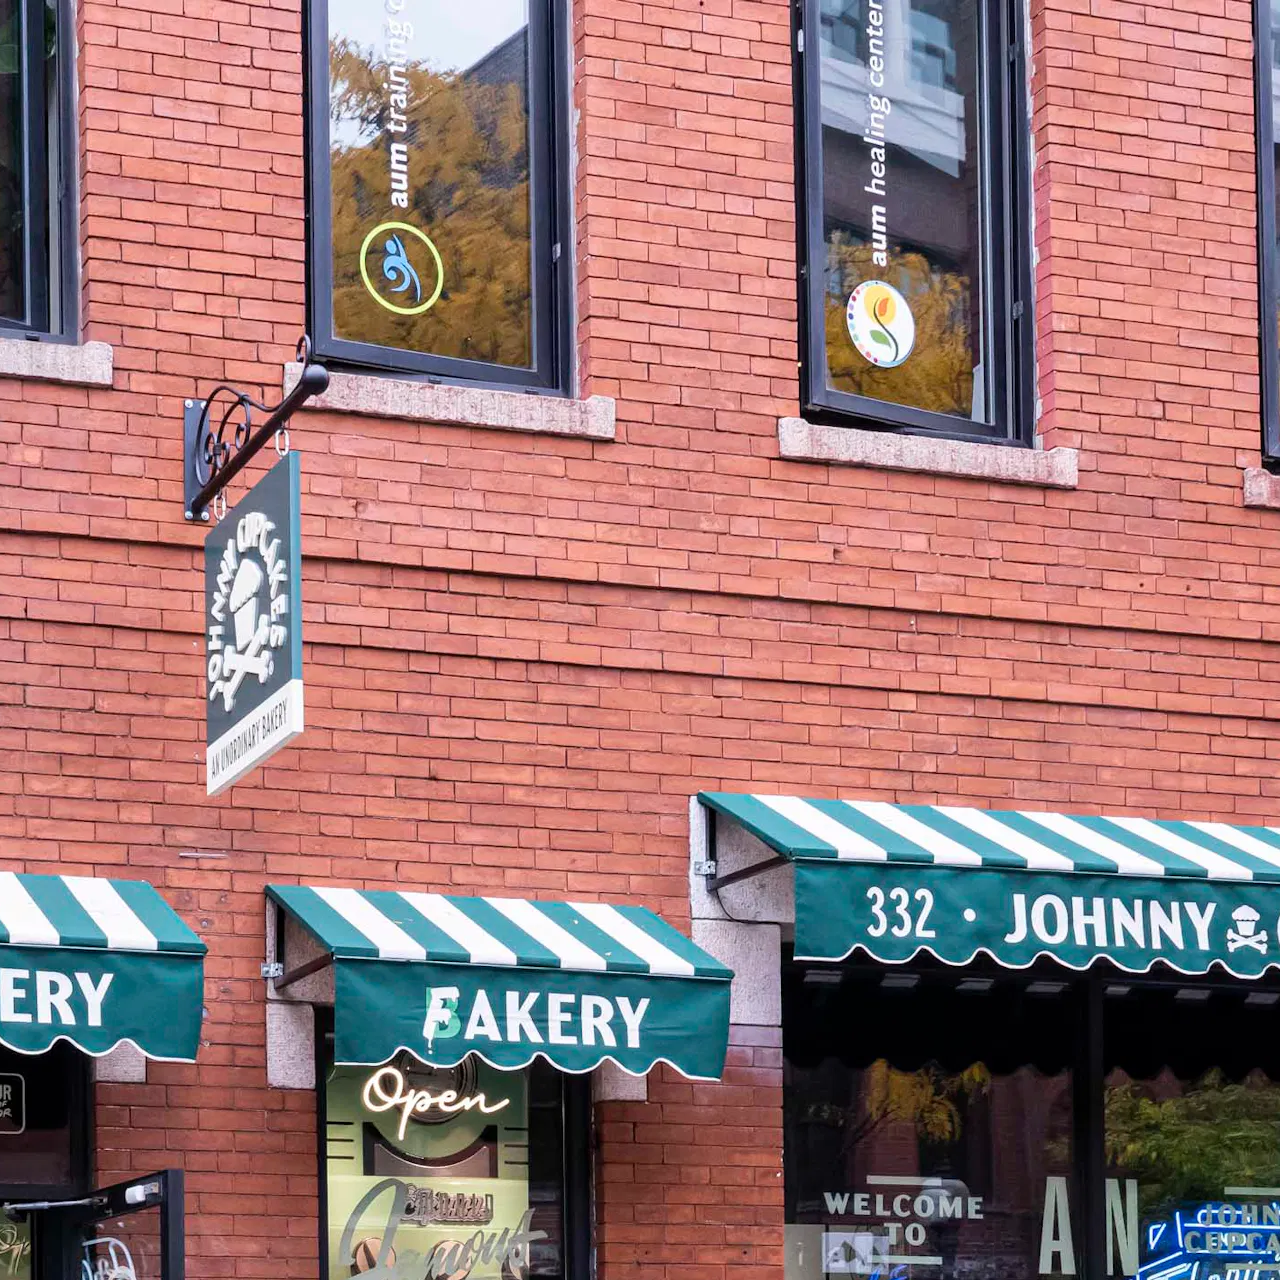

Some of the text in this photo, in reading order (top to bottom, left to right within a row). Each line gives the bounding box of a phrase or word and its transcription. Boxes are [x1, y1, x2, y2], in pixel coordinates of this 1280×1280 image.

[391, 142, 408, 209] aum
[864, 95, 891, 196] healing
[872, 204, 887, 268] aum
[211, 696, 288, 779] AN UNORDINARY BAKERY
[865, 885, 936, 939] 332
[1004, 893, 1215, 952] JOHNNY
[362, 1066, 509, 1141] Open
[823, 1191, 985, 1220] WELCOME
[883, 1222, 927, 1247] TO
